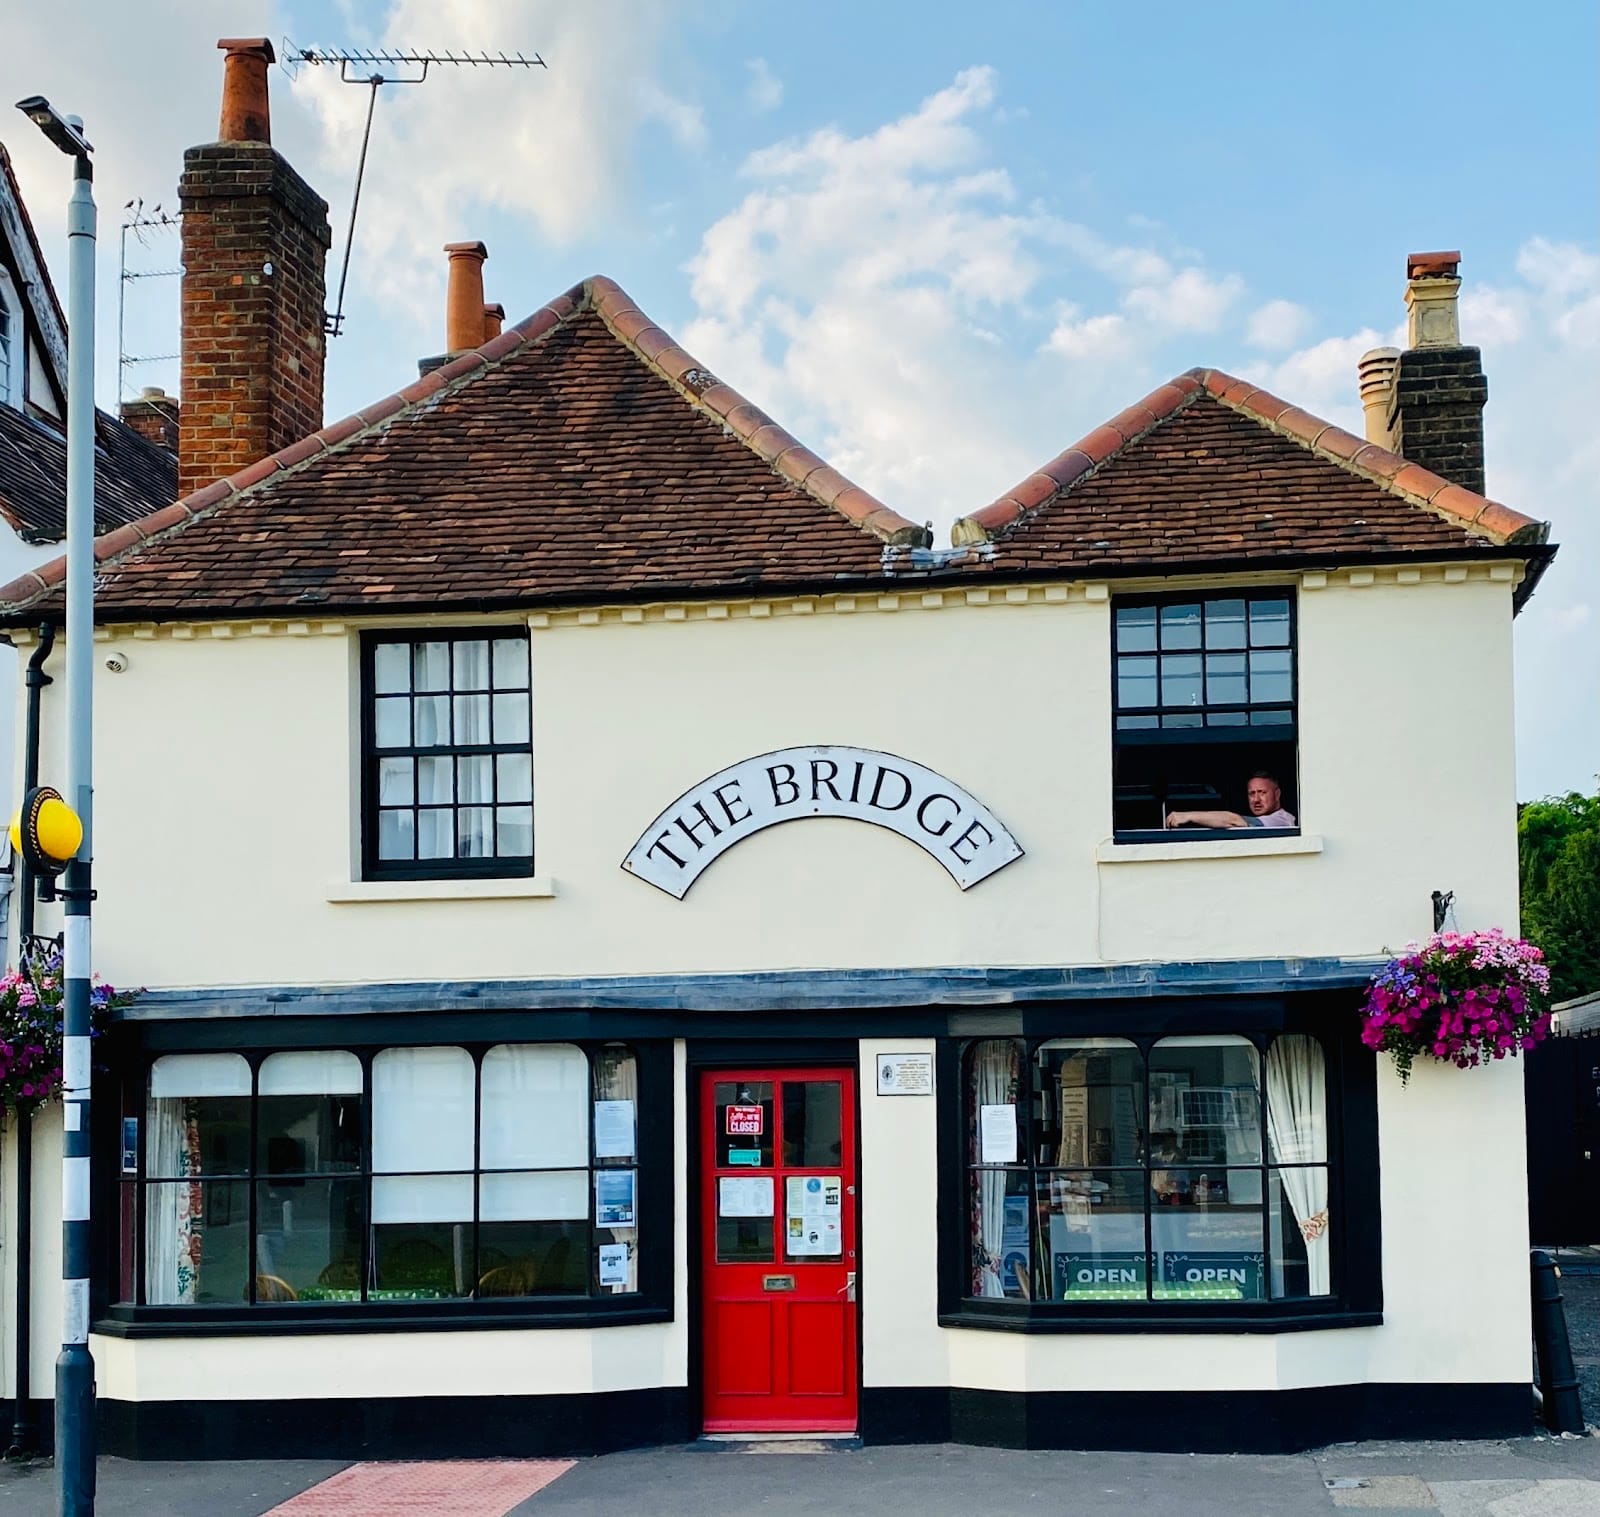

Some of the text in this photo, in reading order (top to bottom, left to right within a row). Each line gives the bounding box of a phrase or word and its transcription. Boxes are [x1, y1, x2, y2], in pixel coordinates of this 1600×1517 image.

[646, 759, 994, 869] THE BRIDGE
[730, 1121, 759, 1132] CLOSED
[1077, 1268, 1137, 1283] OPEN
[1186, 1268, 1247, 1284] OPEN
